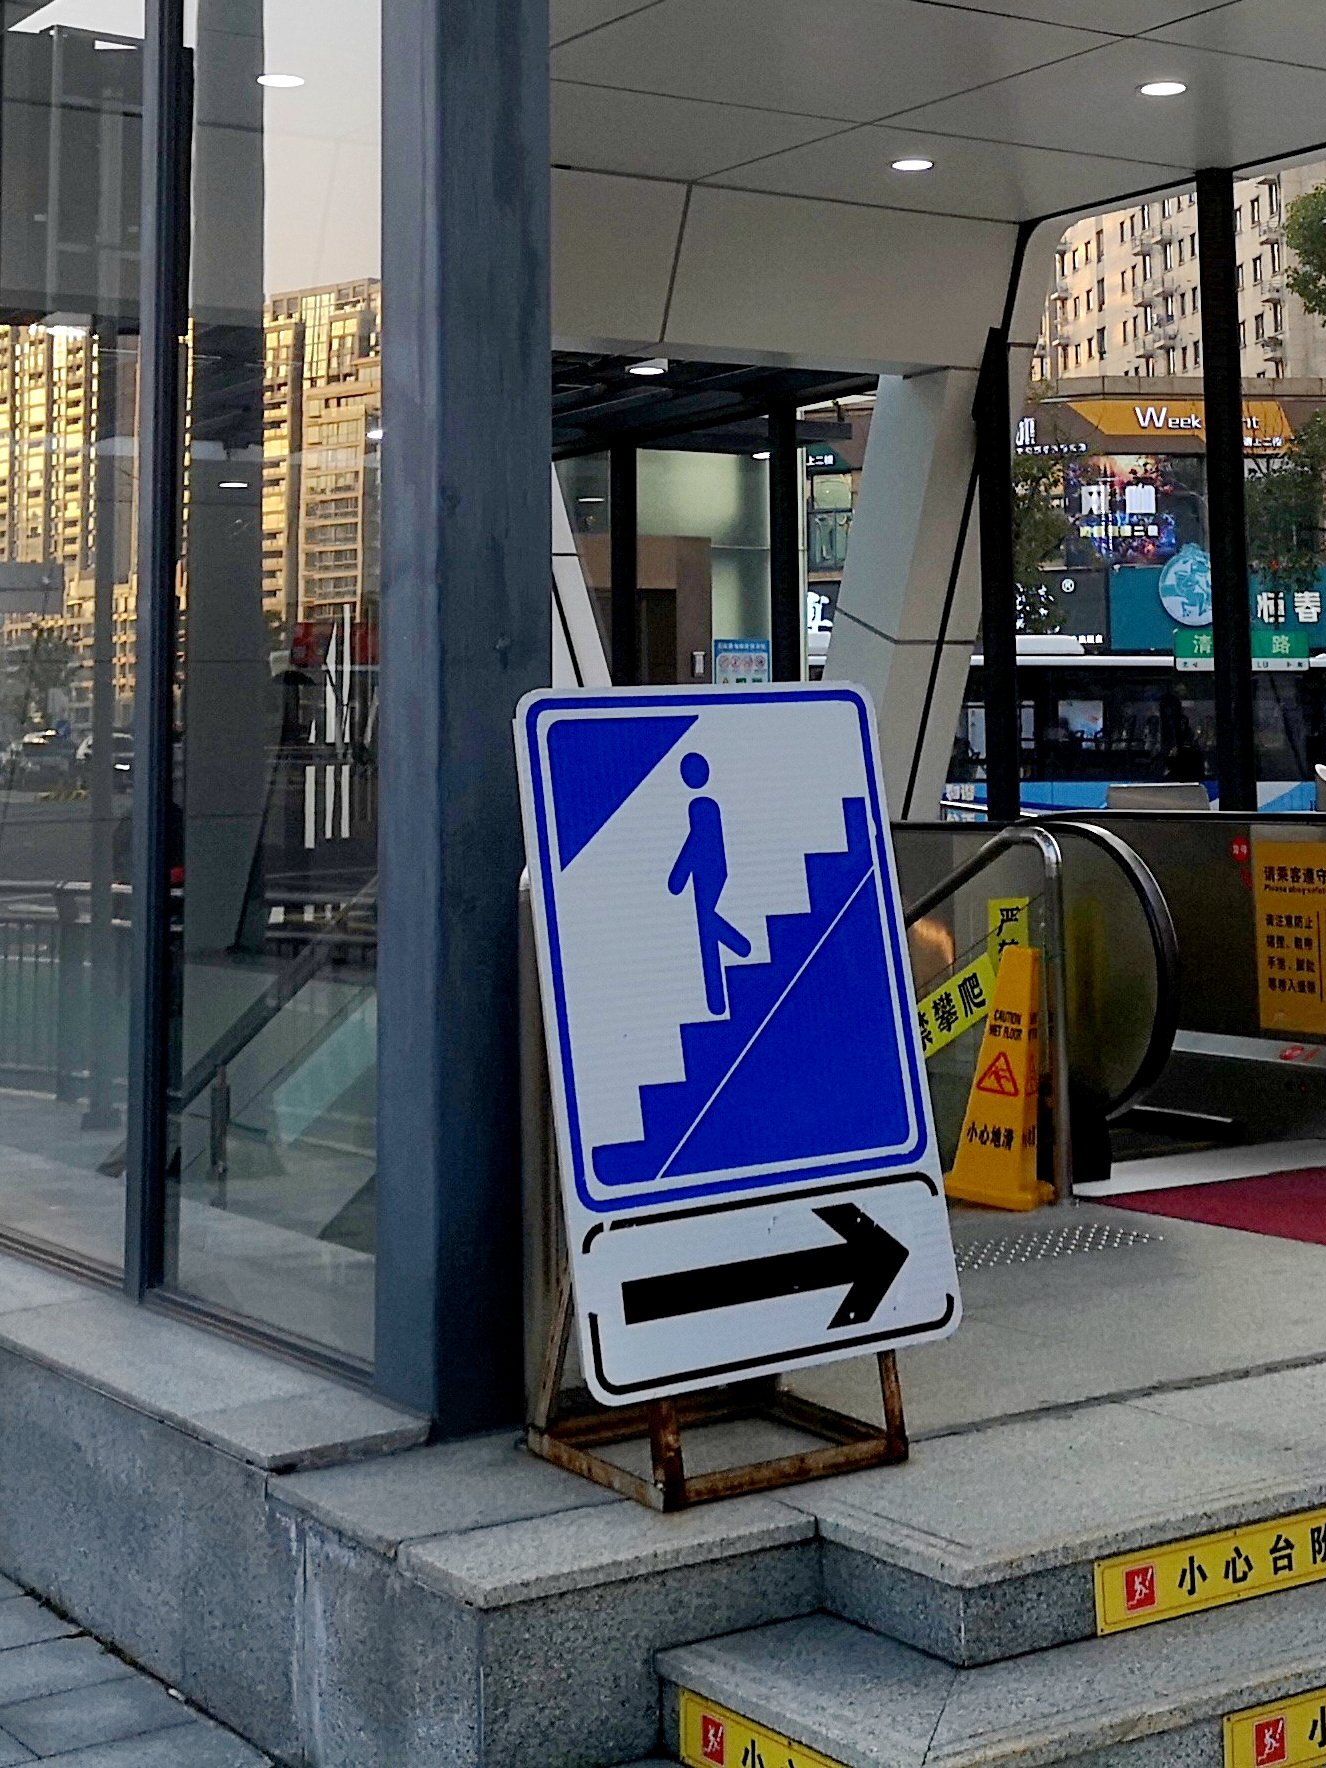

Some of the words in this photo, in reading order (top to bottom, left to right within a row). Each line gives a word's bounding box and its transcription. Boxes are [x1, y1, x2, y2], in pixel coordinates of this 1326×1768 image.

[993, 1009, 1022, 1025] CAUTION
[989, 1024, 1003, 1037] WET
[1003, 1026, 1023, 1041] FLOOR
[966, 1120, 1015, 1151] 小心地滑
[742, 1739, 796, 1768] 小
